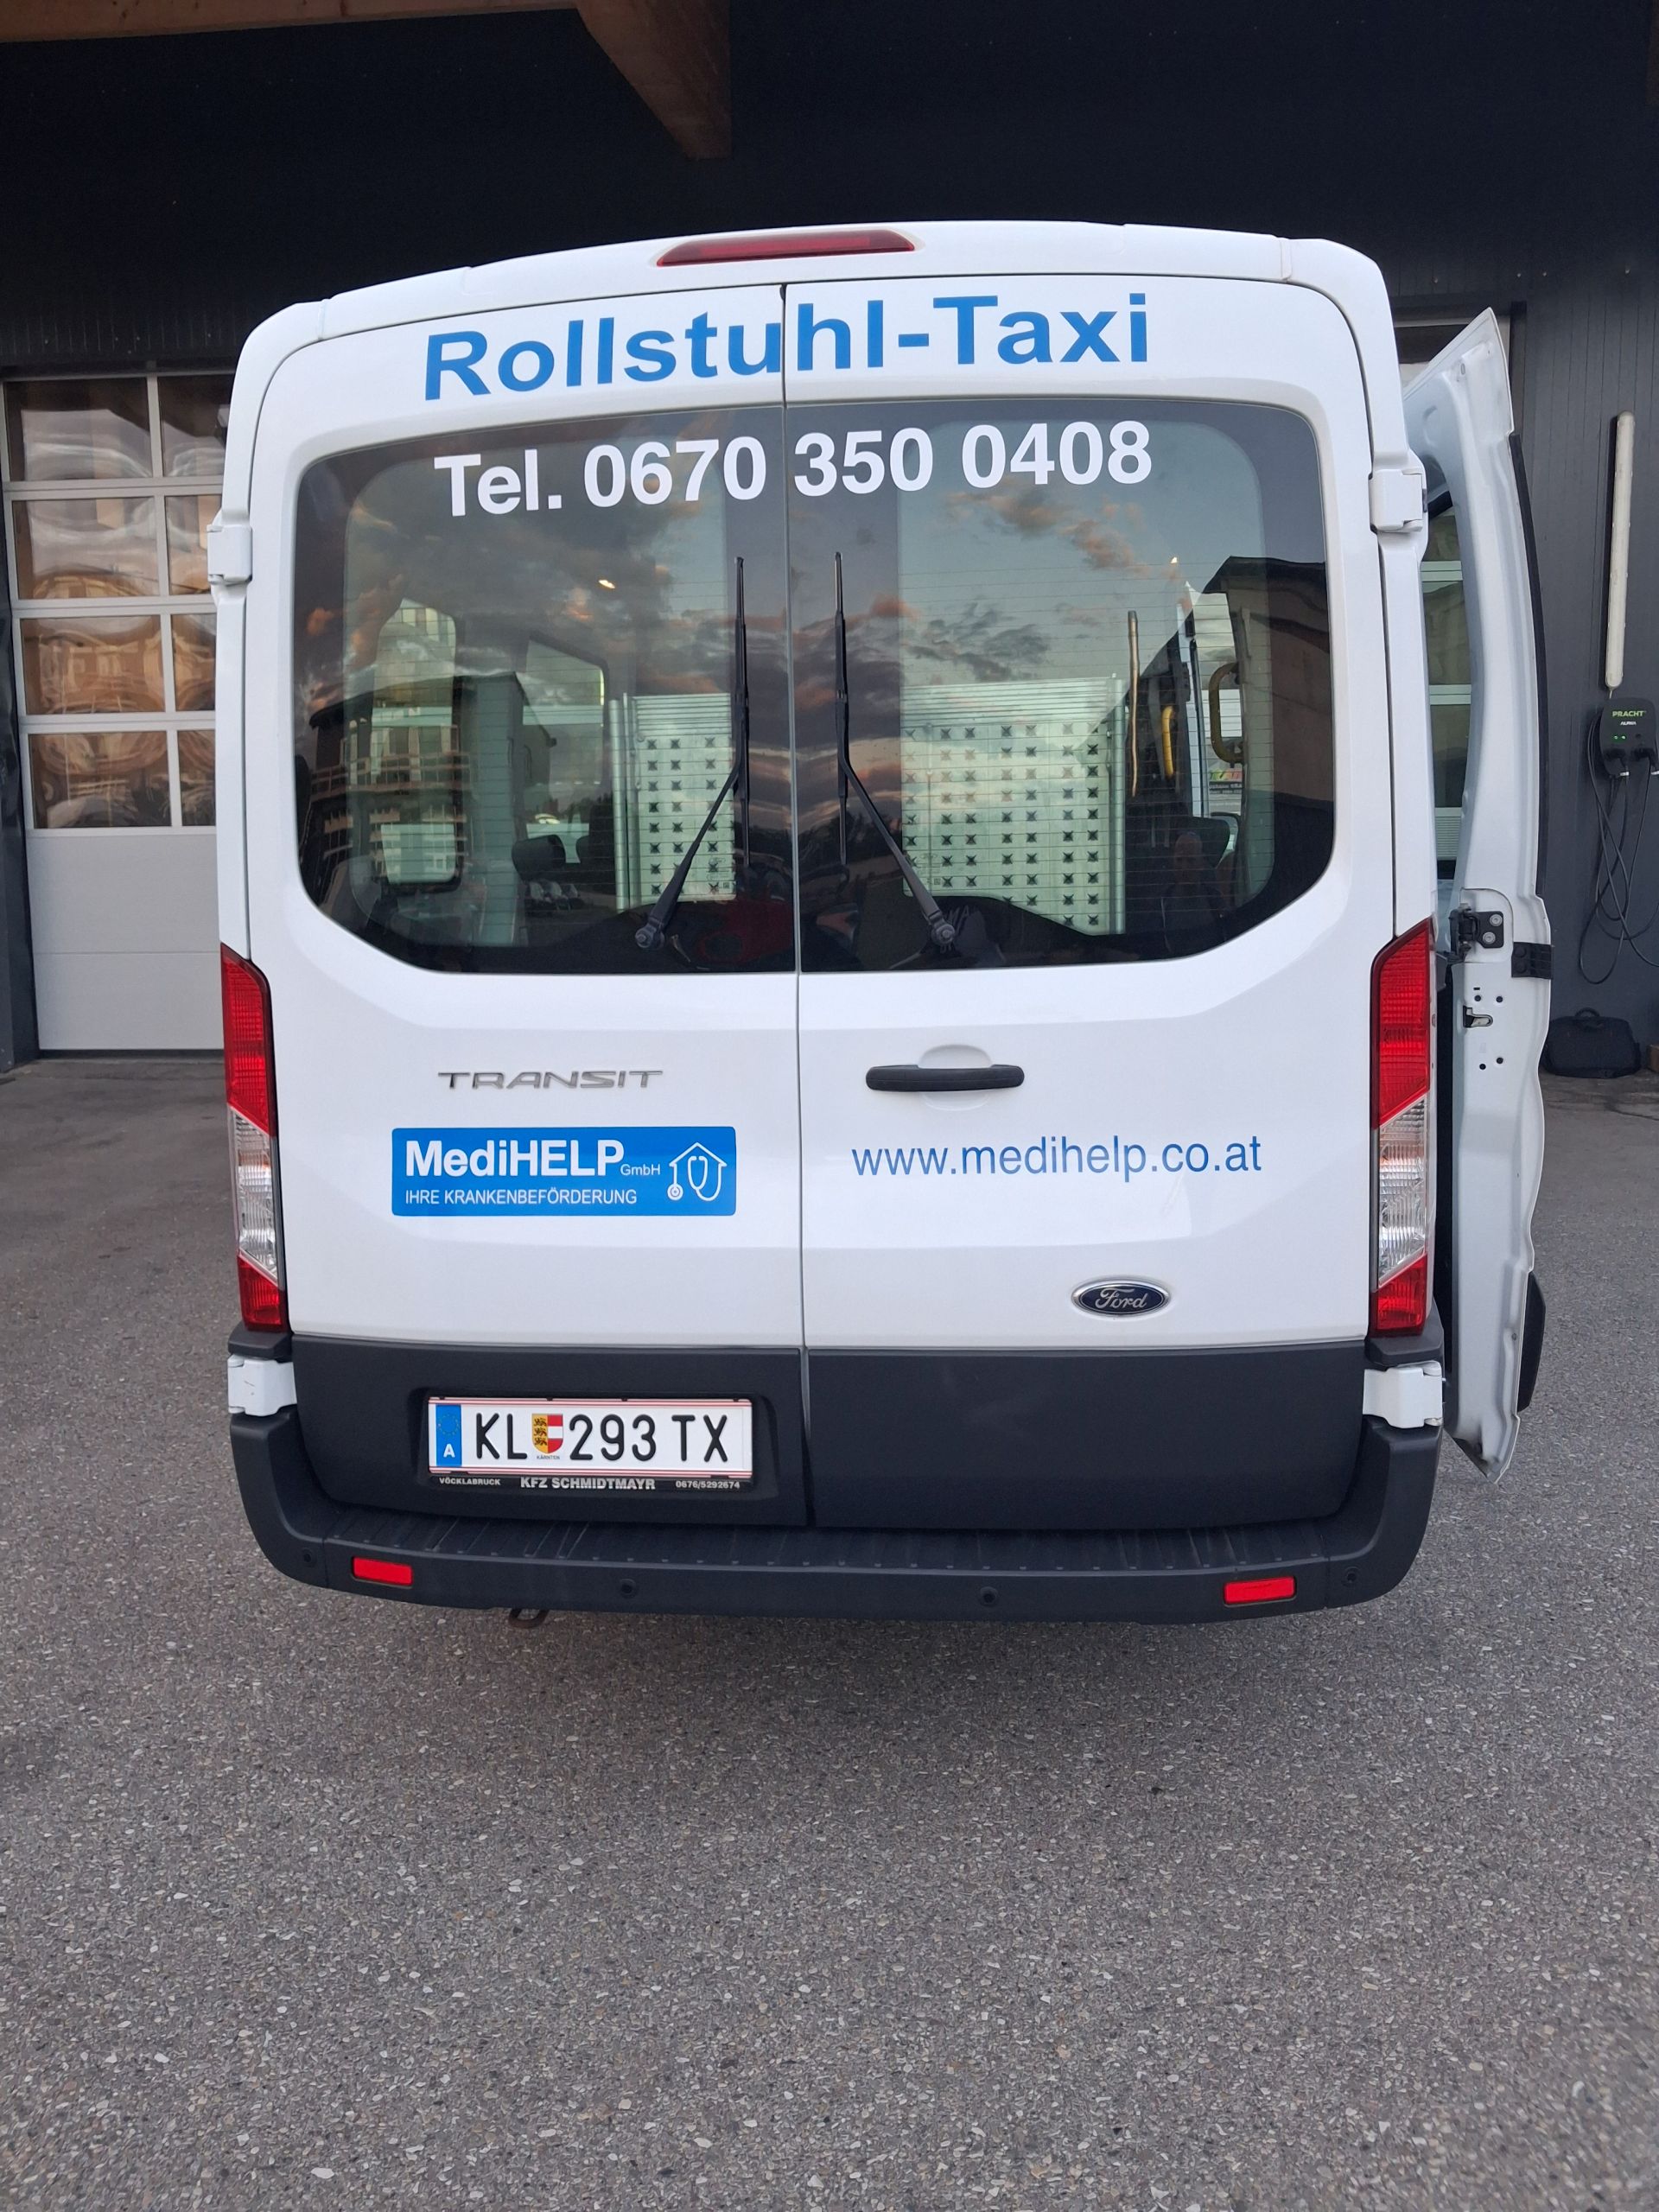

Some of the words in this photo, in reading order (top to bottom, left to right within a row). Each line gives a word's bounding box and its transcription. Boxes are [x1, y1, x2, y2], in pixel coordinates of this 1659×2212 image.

[424, 293, 1148, 401] Rollstuhl-Taxi
[434, 448, 563, 518] Tel.
[583, 436, 767, 508] 0670
[793, 428, 934, 497] 350
[962, 420, 1153, 490] 0408
[438, 1070, 664, 1090] TRANSIT
[405, 1140, 625, 1177] MediHELP
[620, 1163, 661, 1177] GmbH
[851, 1135, 1262, 1183] www.medihelp.co.at
[405, 1189, 440, 1205] IHRE
[444, 1186, 637, 1205] KRANKENBEFÖRDERUNG
[1094, 1287, 1147, 1310] Ford
[476, 1413, 528, 1460] KL
[569, 1414, 657, 1462] 293
[671, 1414, 728, 1463] TX
[442, 1444, 455, 1459] A
[439, 1476, 501, 1486] VÖCKLABRUCK
[520, 1478, 548, 1489] KFZ
[550, 1478, 657, 1491] SCHMIDTMAYR
[675, 1479, 741, 1491] 0676/5292674
